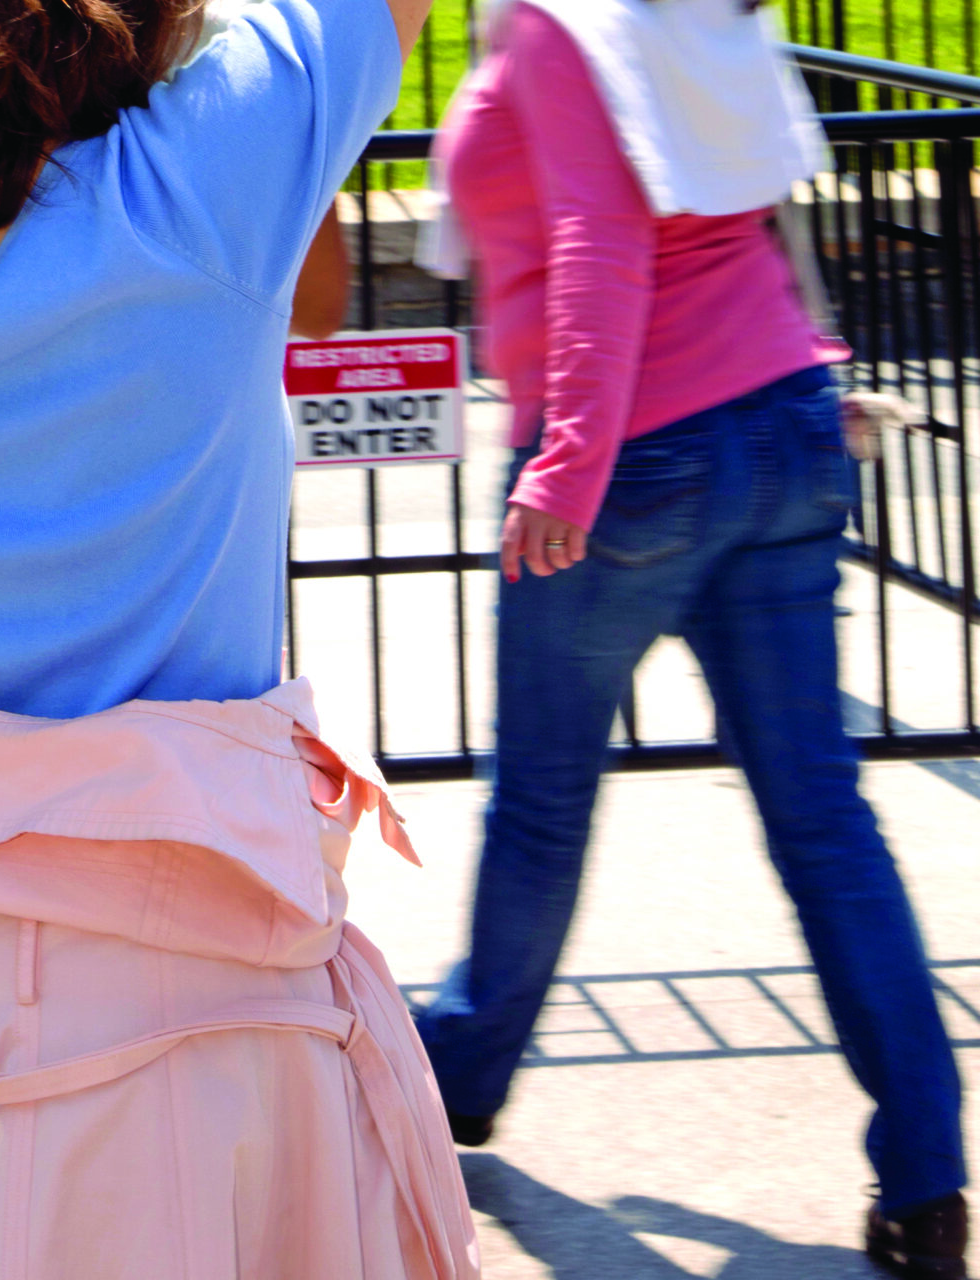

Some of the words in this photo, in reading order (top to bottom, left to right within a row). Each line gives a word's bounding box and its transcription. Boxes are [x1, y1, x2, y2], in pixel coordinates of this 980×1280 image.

[289, 342, 452, 368] RESTRICTED
[335, 367, 407, 389] AREA
[300, 399, 353, 425] DO
[366, 394, 444, 422] NOT
[311, 426, 438, 456] ENTER
